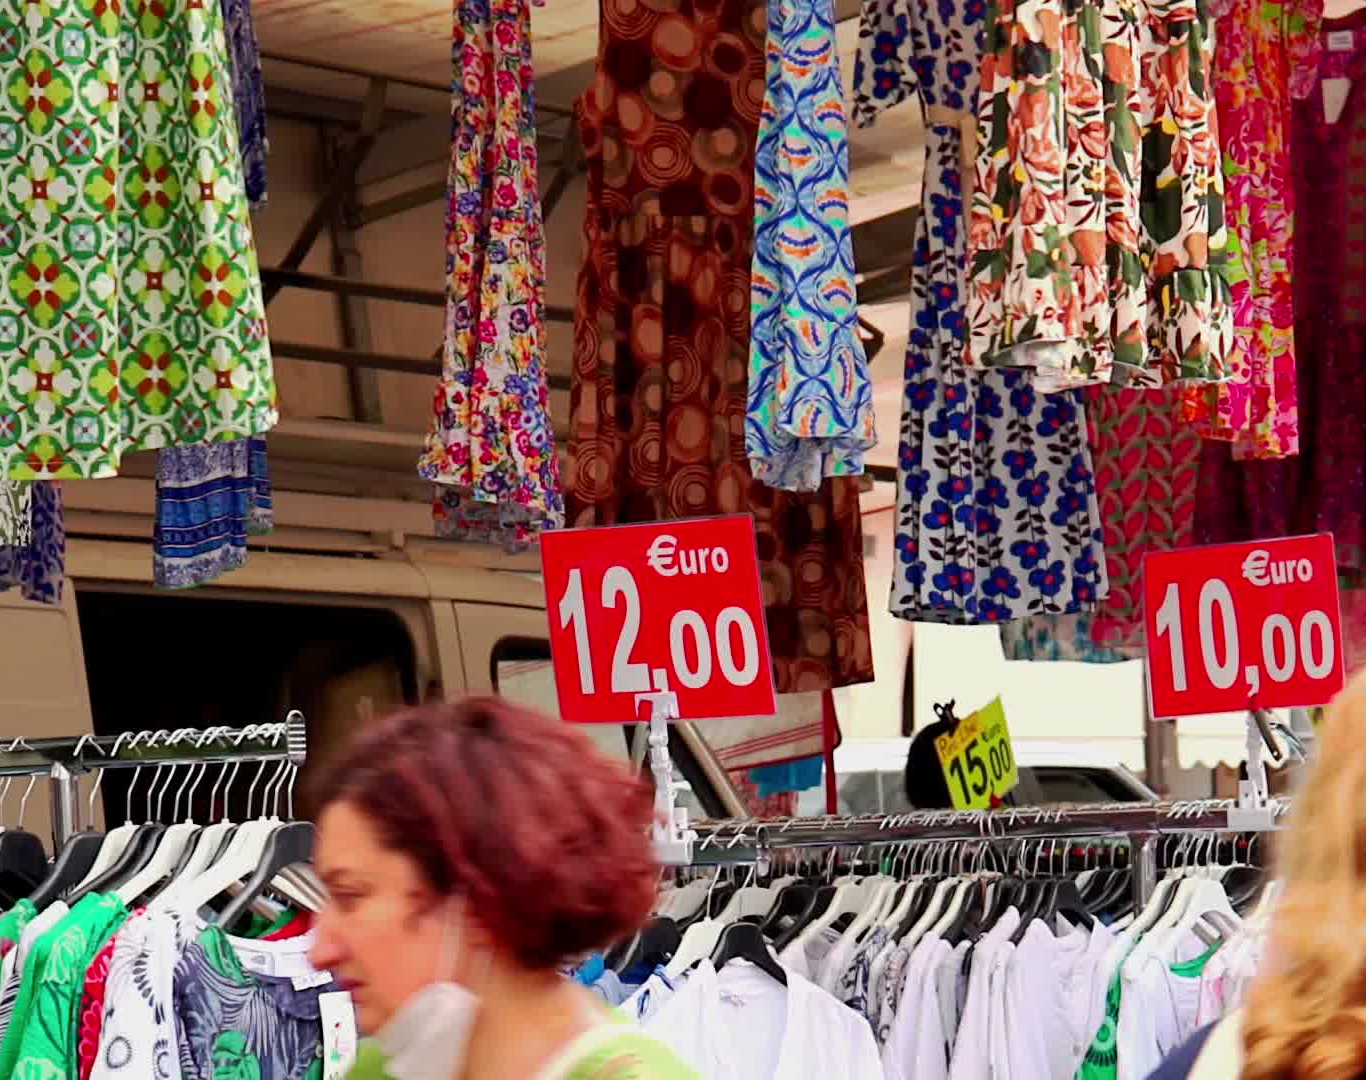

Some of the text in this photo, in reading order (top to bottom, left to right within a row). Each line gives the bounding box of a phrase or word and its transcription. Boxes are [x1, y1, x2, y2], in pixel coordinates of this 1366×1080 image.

[646, 535, 729, 576] €uro
[1241, 550, 1312, 586] €uro
[559, 566, 759, 694] 12,00
[1156, 578, 1334, 697] 10,00
[950, 738, 1011, 805] 15,00
